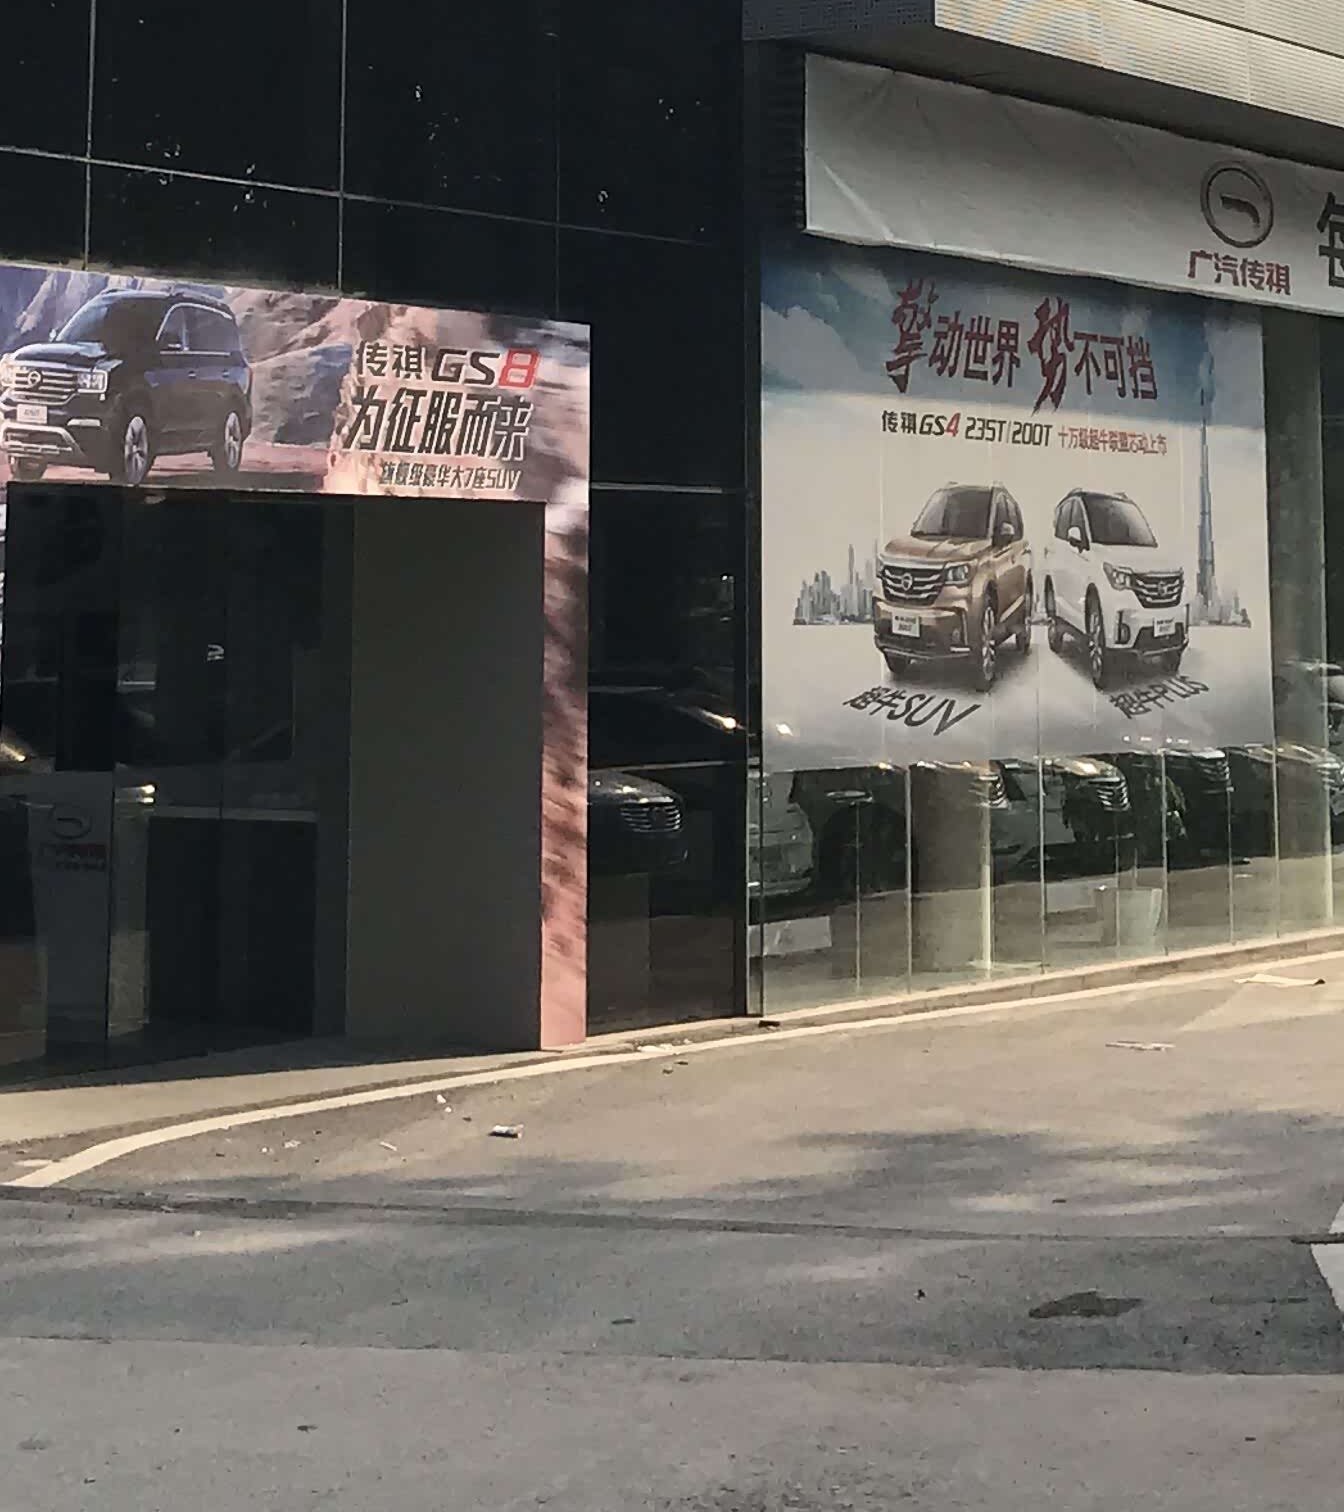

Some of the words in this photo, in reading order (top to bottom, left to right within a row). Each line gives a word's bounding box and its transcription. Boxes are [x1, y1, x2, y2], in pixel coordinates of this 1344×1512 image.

[1187, 249, 1292, 297] 广汽传祺
[356, 340, 424, 381] 传祺
[430, 347, 542, 389] GS8
[342, 384, 535, 462] 为征服而来
